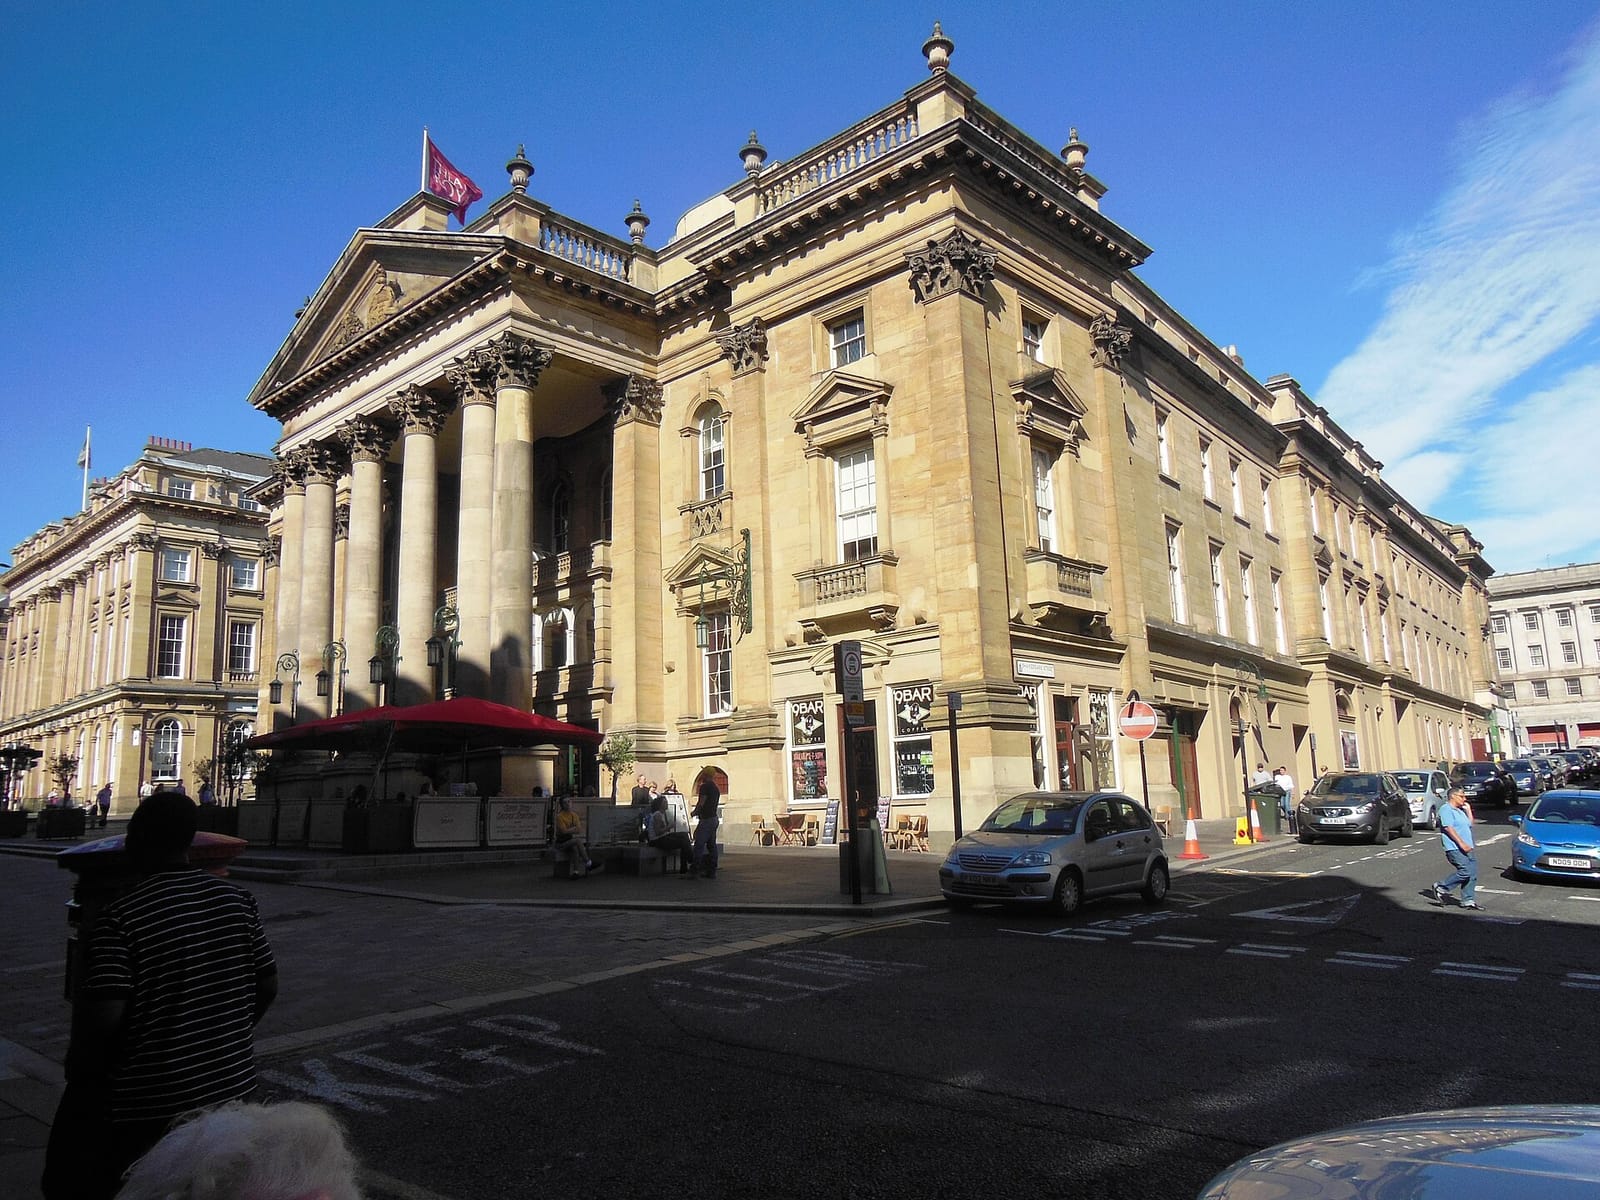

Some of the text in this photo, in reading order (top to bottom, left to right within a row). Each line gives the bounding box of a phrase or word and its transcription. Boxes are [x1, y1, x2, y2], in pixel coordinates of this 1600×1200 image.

[895, 687, 932, 704] 9BAR
[1089, 692, 1108, 707] BAR
[792, 701, 824, 716] 9BAR
[257, 1014, 606, 1113] KEEP
